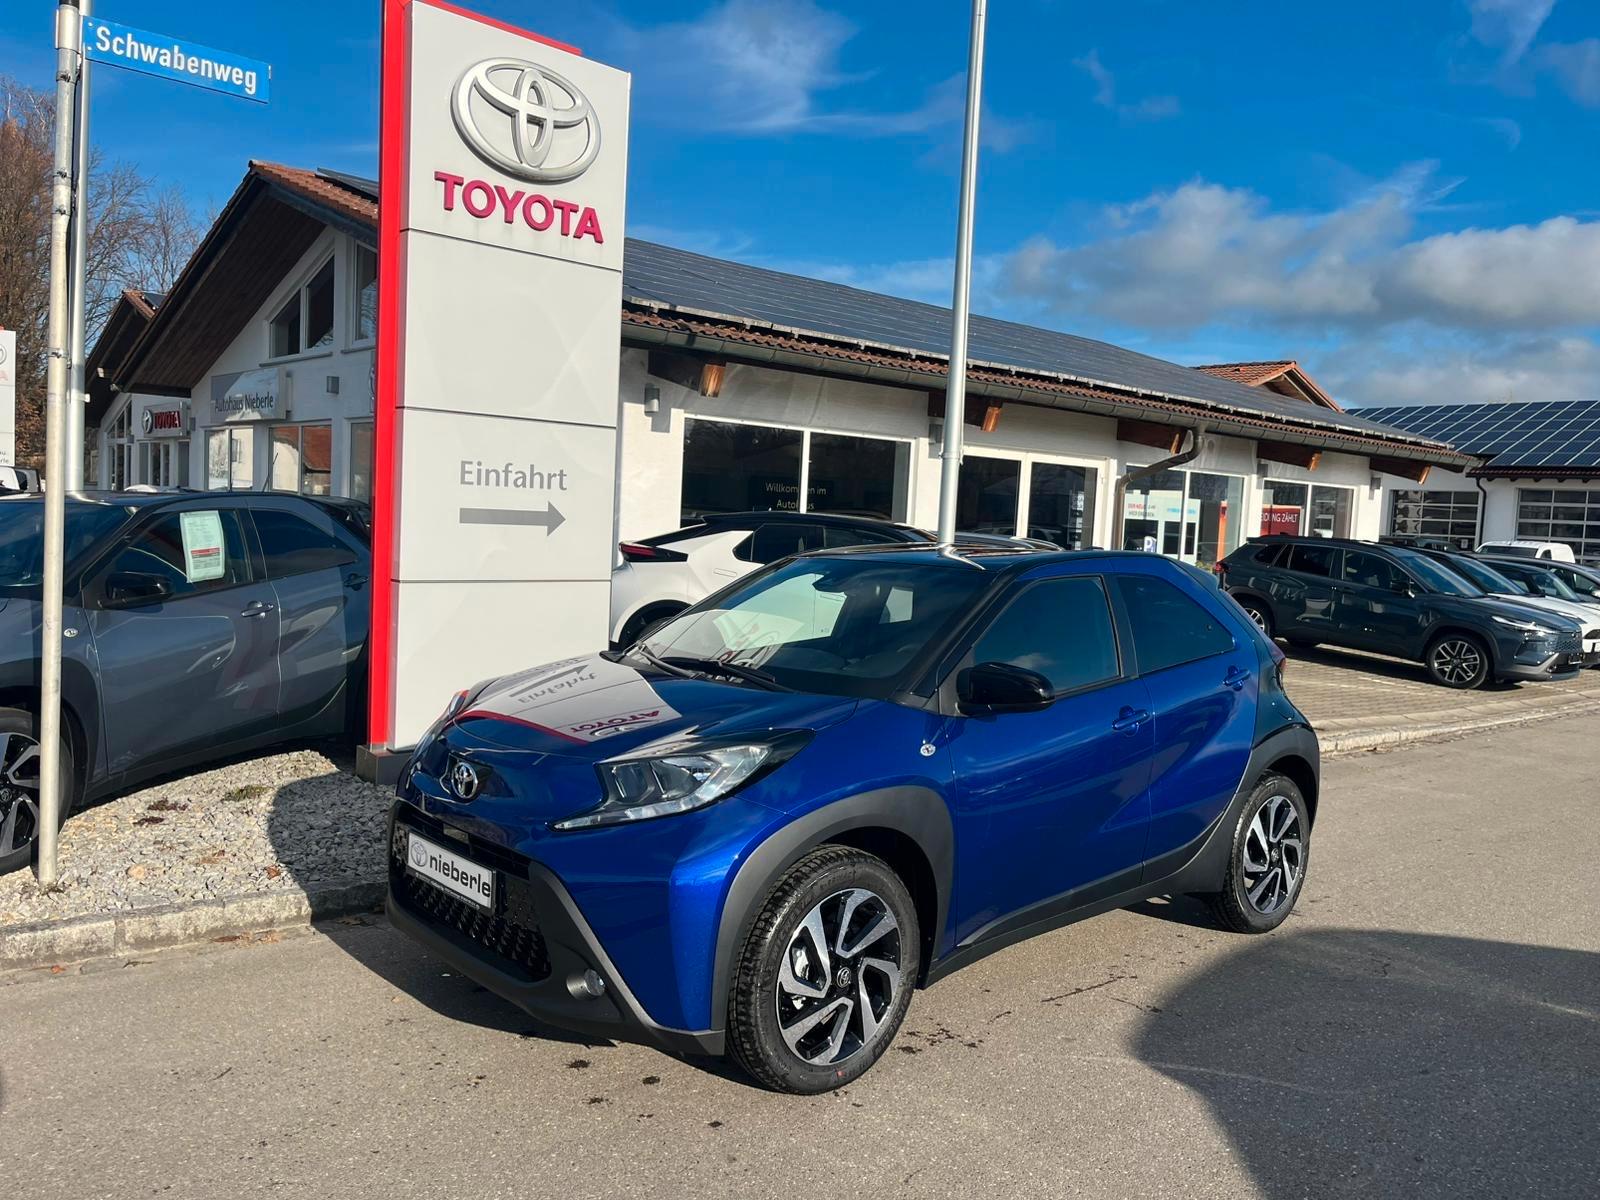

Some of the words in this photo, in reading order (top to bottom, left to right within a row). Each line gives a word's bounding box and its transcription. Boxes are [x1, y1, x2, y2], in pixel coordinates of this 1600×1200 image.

[96, 26, 257, 95] Schwabenweg
[434, 171, 604, 244] TOYOTA
[214, 396, 244, 412] Autohaus
[245, 391, 274, 409] Nieberle
[154, 410, 182, 430] TOYOTA
[460, 460, 567, 491] Einfahrt
[765, 482, 816, 495] Willkomen
[816, 486, 827, 495] im
[776, 499, 815, 510] Autous
[429, 854, 491, 898] nieberle
